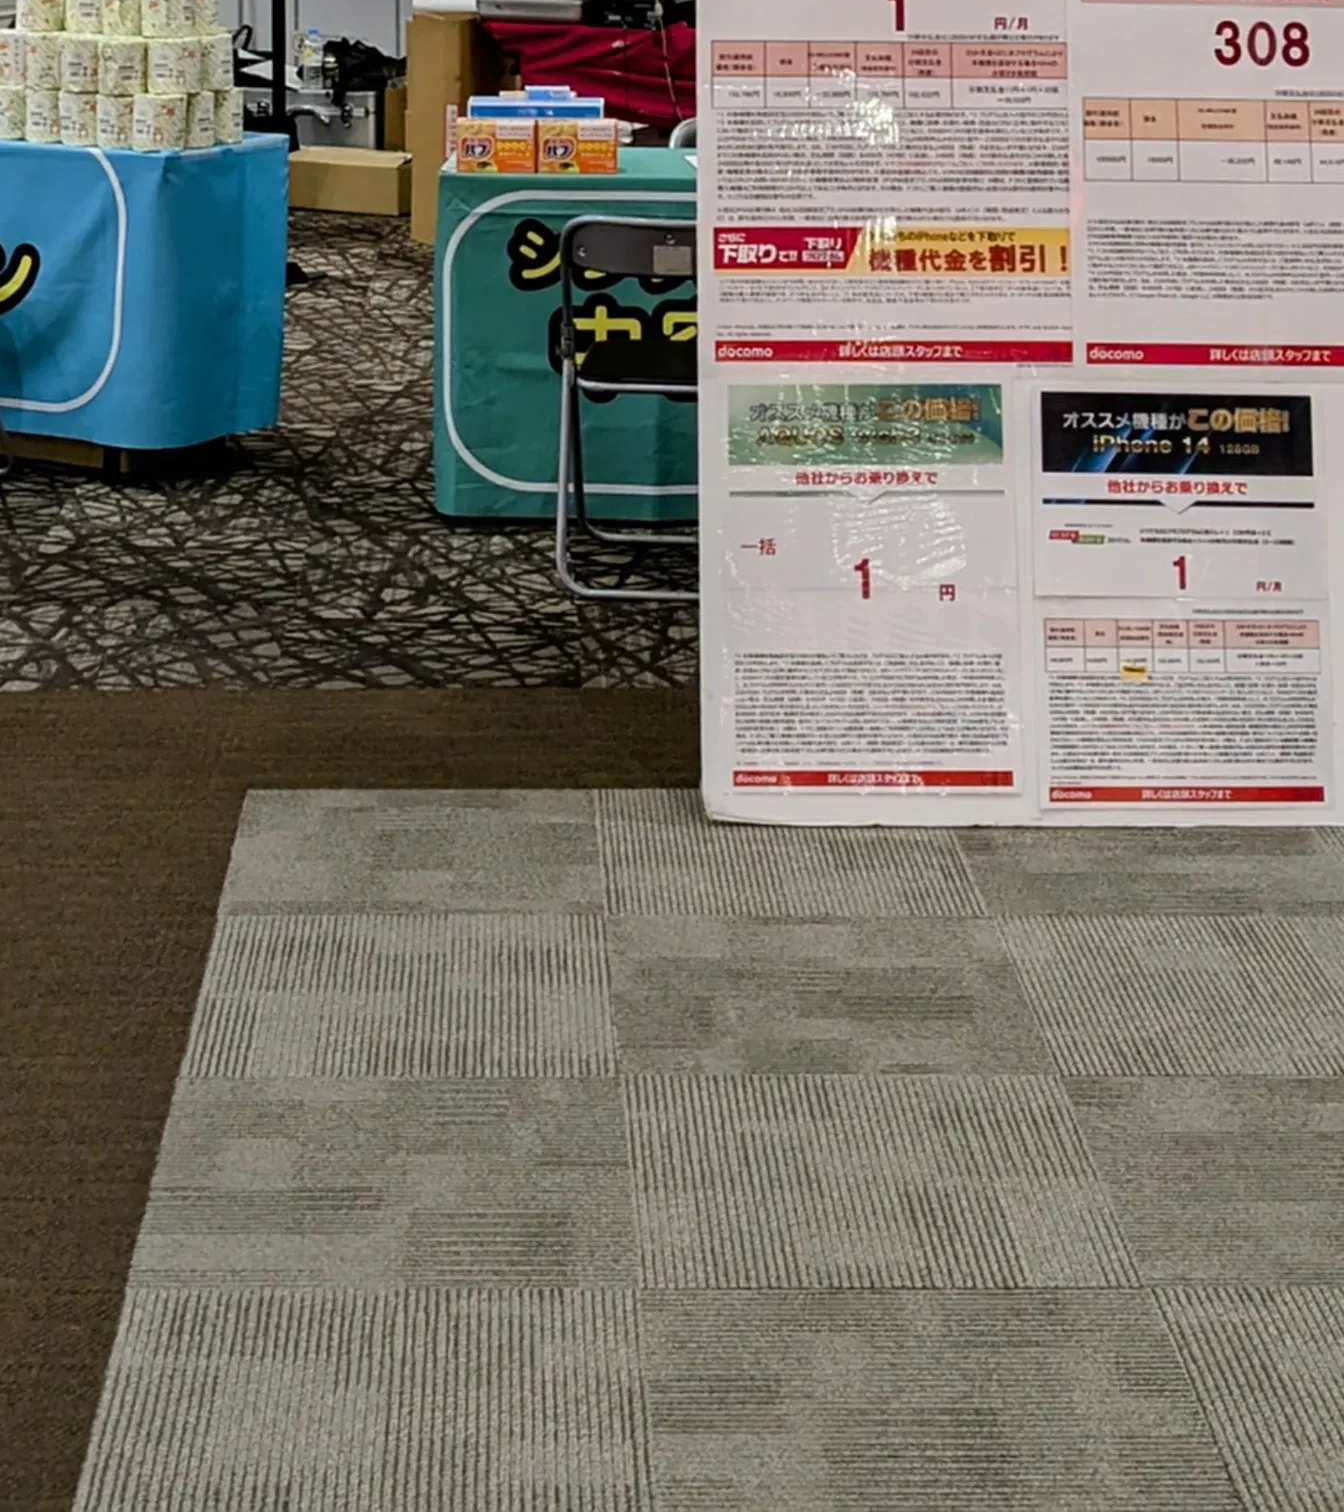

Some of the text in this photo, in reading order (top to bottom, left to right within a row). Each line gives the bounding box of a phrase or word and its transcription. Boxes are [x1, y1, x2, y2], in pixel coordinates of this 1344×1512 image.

[994, 17, 1029, 31] 円/月
[1214, 20, 1311, 67] 308
[869, 244, 1069, 273] 機種代金を割引!
[717, 346, 774, 358] docomo
[1089, 348, 1145, 361] docomo
[1092, 435, 1173, 454] iPhone
[1182, 437, 1212, 455] 14
[796, 471, 939, 486] 他社からお乗り換えで
[1108, 480, 1248, 495] 他社からお乗り換えで
[854, 558, 871, 601] 1
[1172, 556, 1187, 591] 1
[939, 584, 956, 602] 円
[735, 774, 777, 784] docomo
[1051, 790, 1093, 800] docomo
